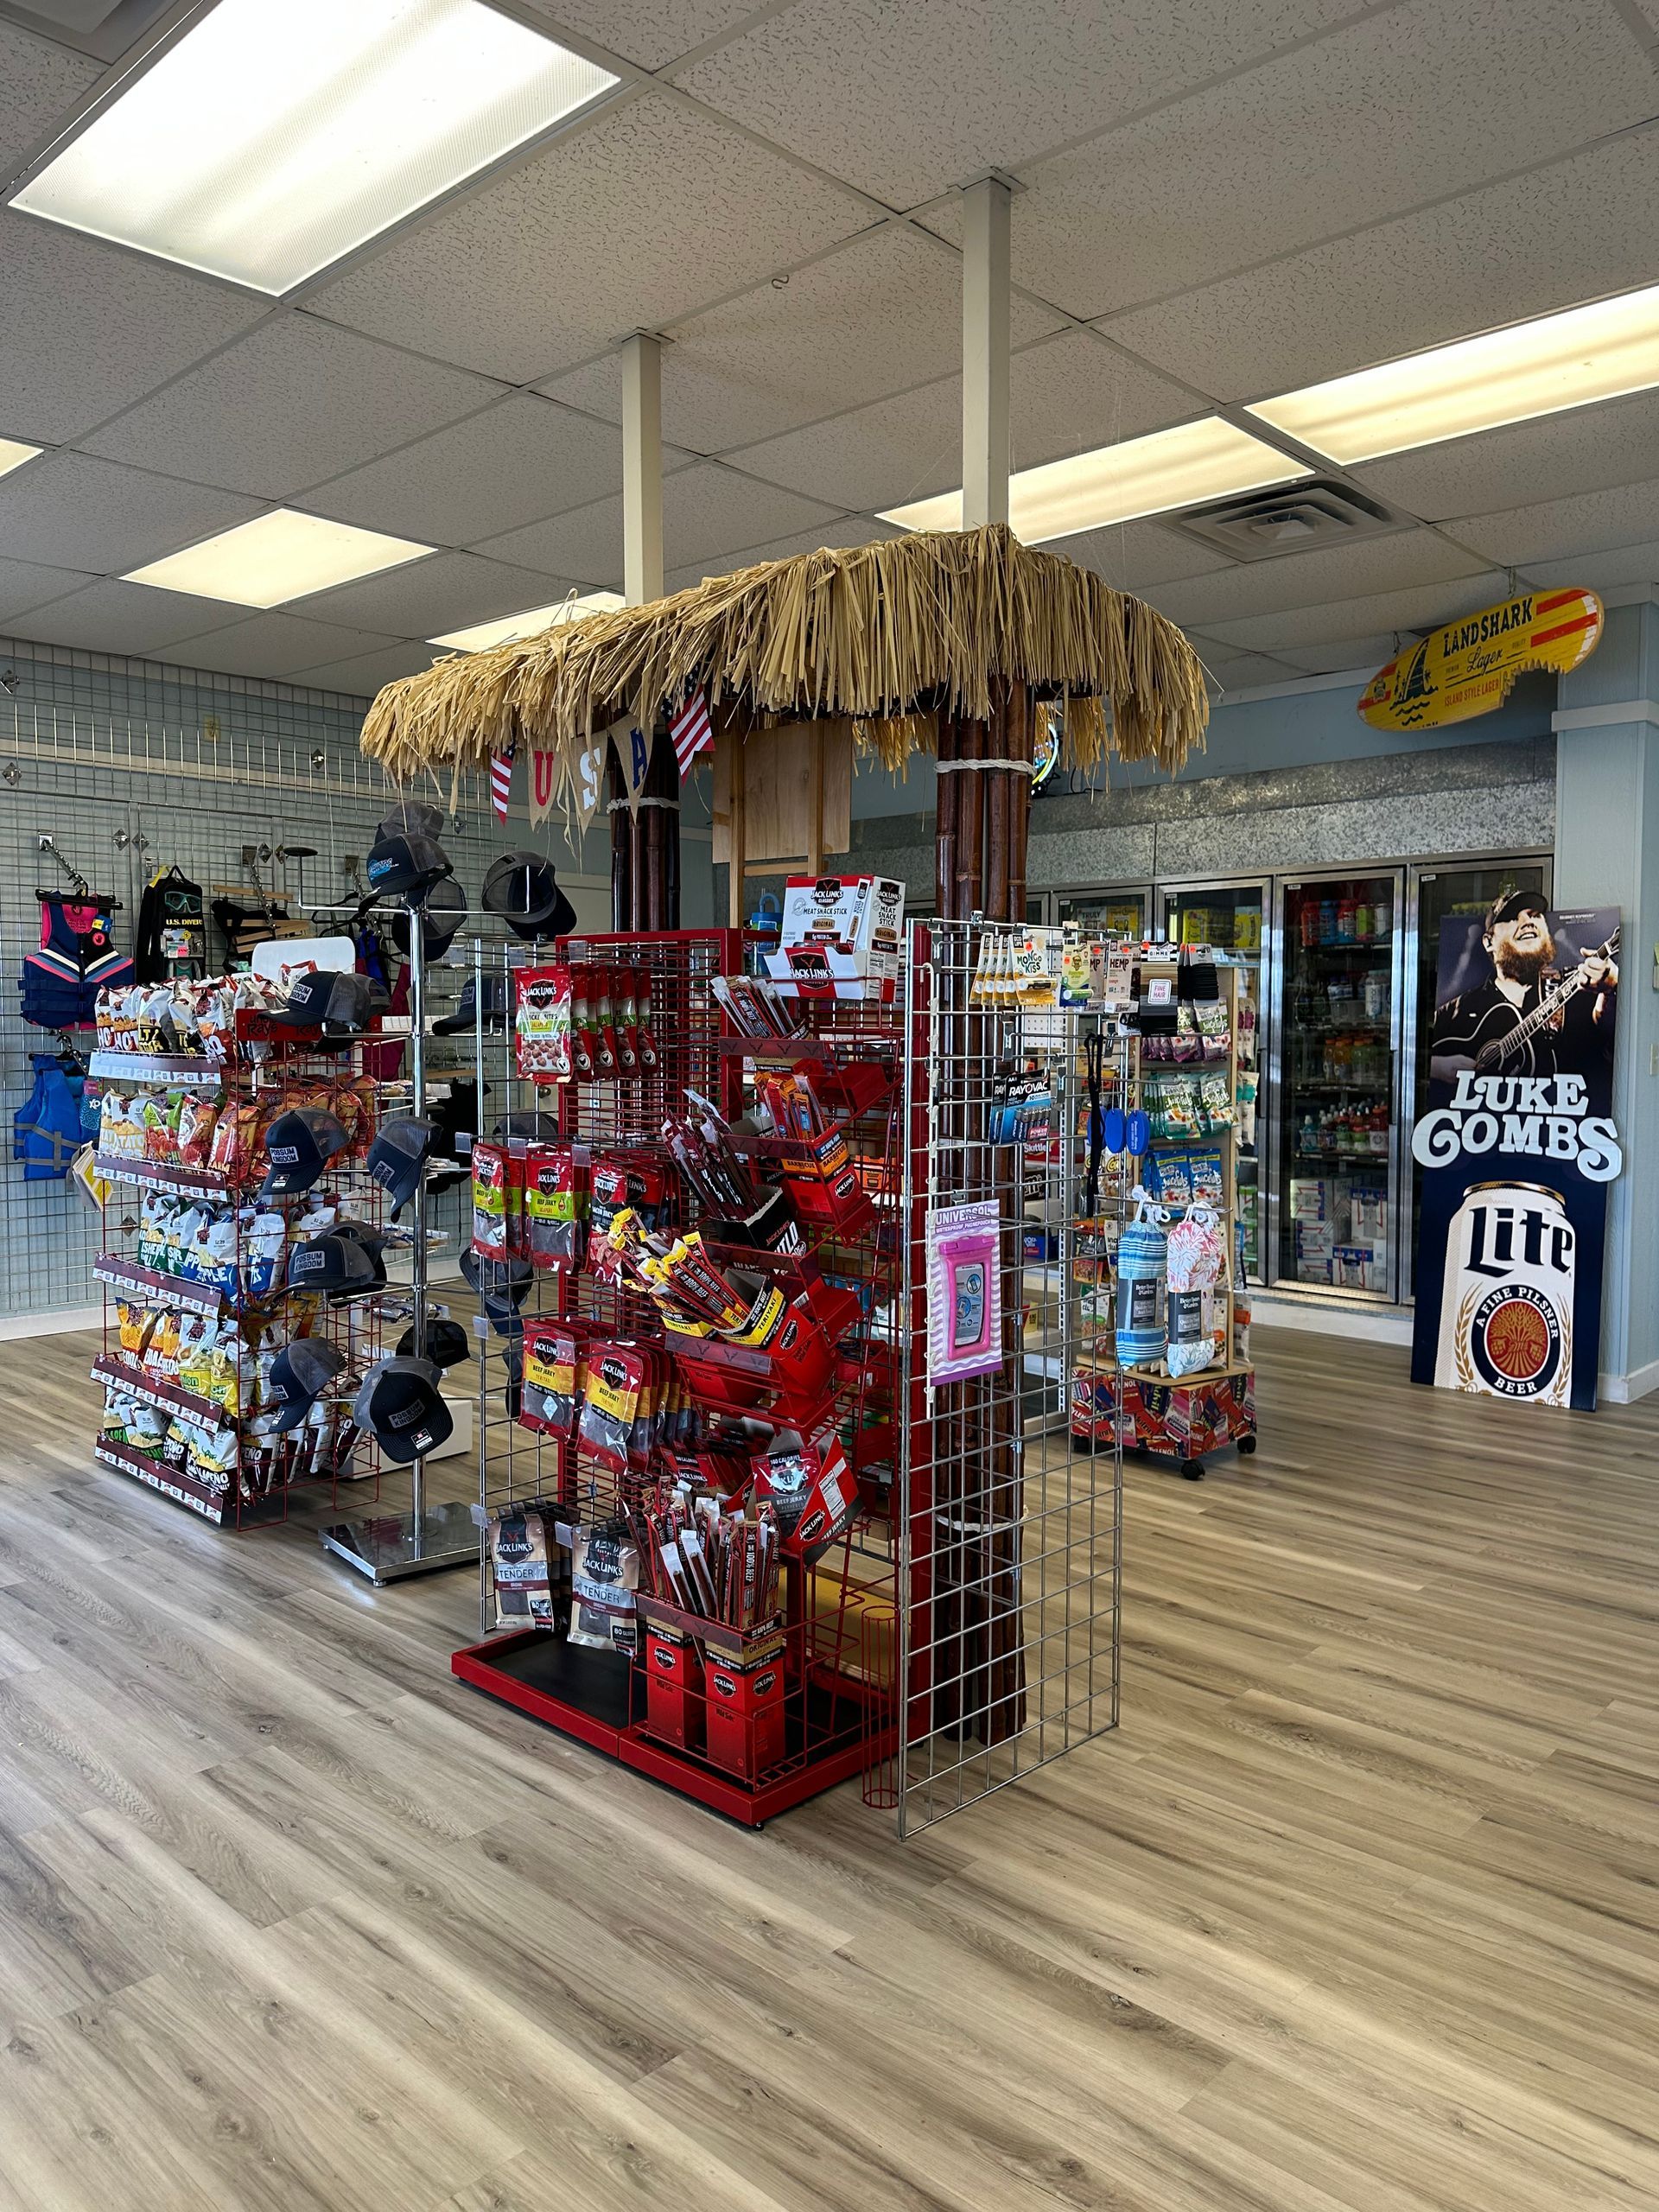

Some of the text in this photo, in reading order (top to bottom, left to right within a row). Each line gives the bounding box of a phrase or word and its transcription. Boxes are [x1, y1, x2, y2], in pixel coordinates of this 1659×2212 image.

[1443, 596, 1533, 658] LANDSHARK
[1466, 645, 1503, 676] Lager
[1444, 678, 1499, 707] ISLAND STYLE LAGER
[880, 906, 896, 914] MEAT
[1017, 950, 1042, 967] MONGO
[1090, 958, 1101, 971] MP
[1109, 958, 1129, 971] HEMP
[1026, 962, 1041, 974] KISS
[527, 988, 540, 996] JACK
[1008, 1081, 1048, 1097] RAYOVAC
[1450, 1070, 1589, 1116] LUKE
[1411, 1109, 1623, 1183] COMBS
[823, 1145, 846, 1167] BARBECUE
[1464, 1206, 1573, 1279] Lite
[295, 1260, 322, 1271] KINGDOM
[296, 1252, 322, 1263] POSSUM
[758, 1298, 777, 1331] TERIYAKI
[1476, 1287, 1559, 1339] A FINE PILSNER
[532, 1341, 545, 1352] JACK
[543, 1369, 555, 1377] JERKY
[600, 1362, 614, 1375] JACK
[1111, 1380, 1136, 1390] TENOL
[1494, 1376, 1537, 1394] BEER
[599, 1387, 620, 1403] BEEF JERKY
[391, 1401, 421, 1422] POSSUM
[393, 1407, 423, 1427] KINGDOM
[778, 1454, 800, 1464] CALORIES
[678, 1471, 691, 1480] JACK
[788, 1495, 807, 1503] JERKY
[831, 1514, 846, 1533] JERKY
[799, 1525, 812, 1541] JACK
[497, 1543, 512, 1553] JACK
[582, 1556, 601, 1571] JACK
[746, 1551, 754, 1582] 100% BEEF
[499, 1569, 534, 1580] TENDER
[583, 1585, 620, 1604] TENDER
